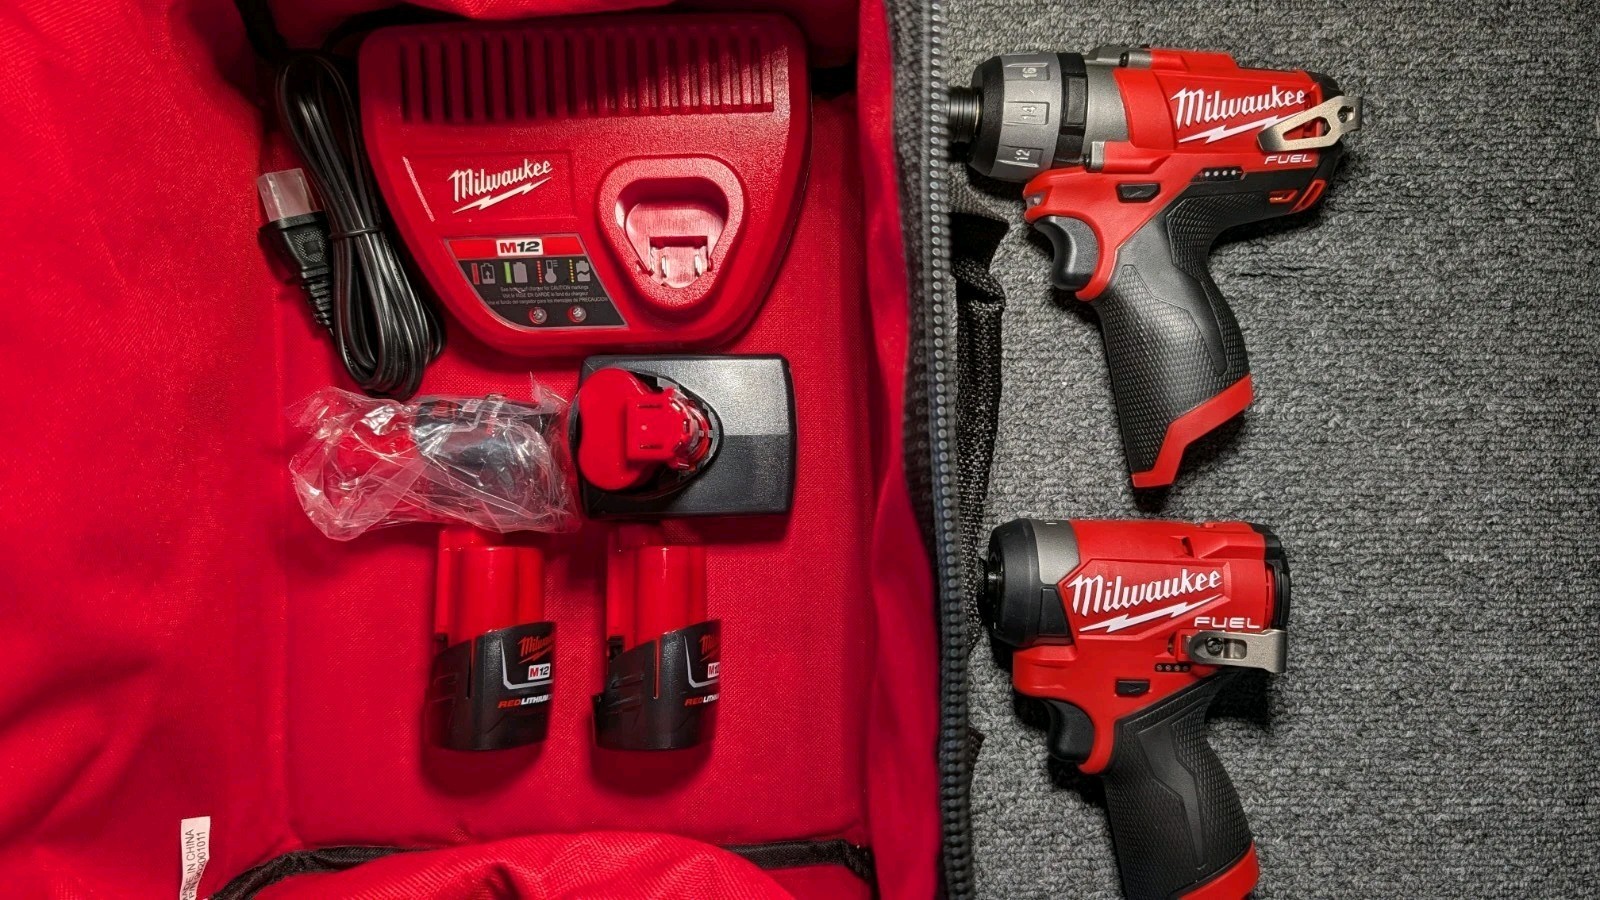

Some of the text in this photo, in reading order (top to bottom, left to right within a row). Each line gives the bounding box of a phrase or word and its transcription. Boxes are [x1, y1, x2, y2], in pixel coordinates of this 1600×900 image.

[1022, 67, 1037, 78] 16
[1170, 85, 1305, 130] Milwaukee
[1014, 149, 1031, 161] 12
[1264, 154, 1313, 165] FUEL
[447, 159, 553, 202] Milwaukee
[499, 241, 540, 253] M12
[1067, 568, 1222, 616] Milwaukee
[1194, 617, 1260, 629] FUEL
[530, 666, 549, 677] M12
[185, 829, 195, 861] CHINA
[187, 863, 196, 874] IN
